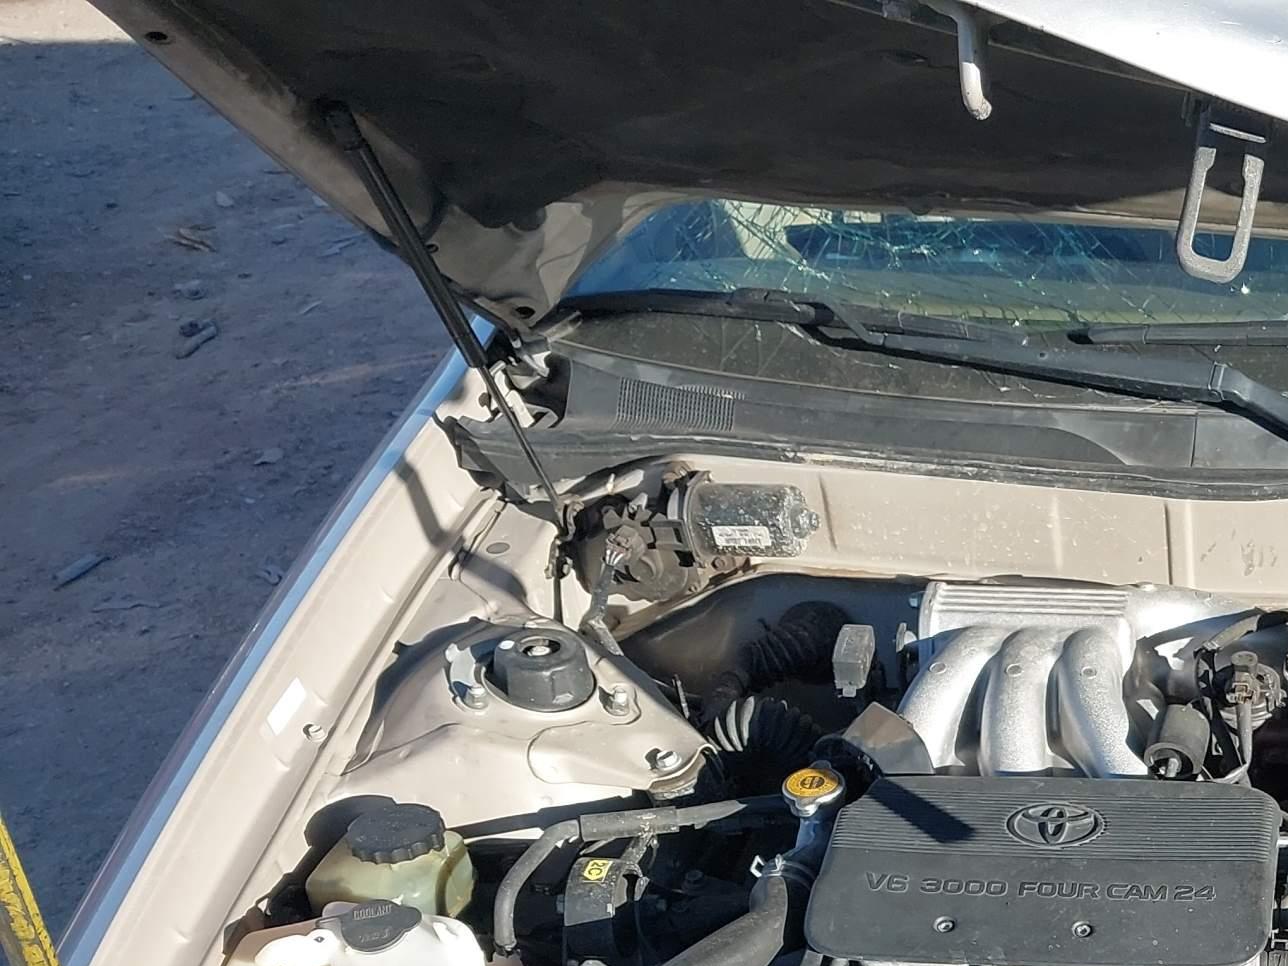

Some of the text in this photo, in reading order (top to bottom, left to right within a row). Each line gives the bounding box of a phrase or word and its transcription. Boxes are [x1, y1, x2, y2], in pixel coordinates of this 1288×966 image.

[866, 872, 1217, 902] V6 3000 FOUR CAM 24
[353, 904, 393, 920] COOLANT
